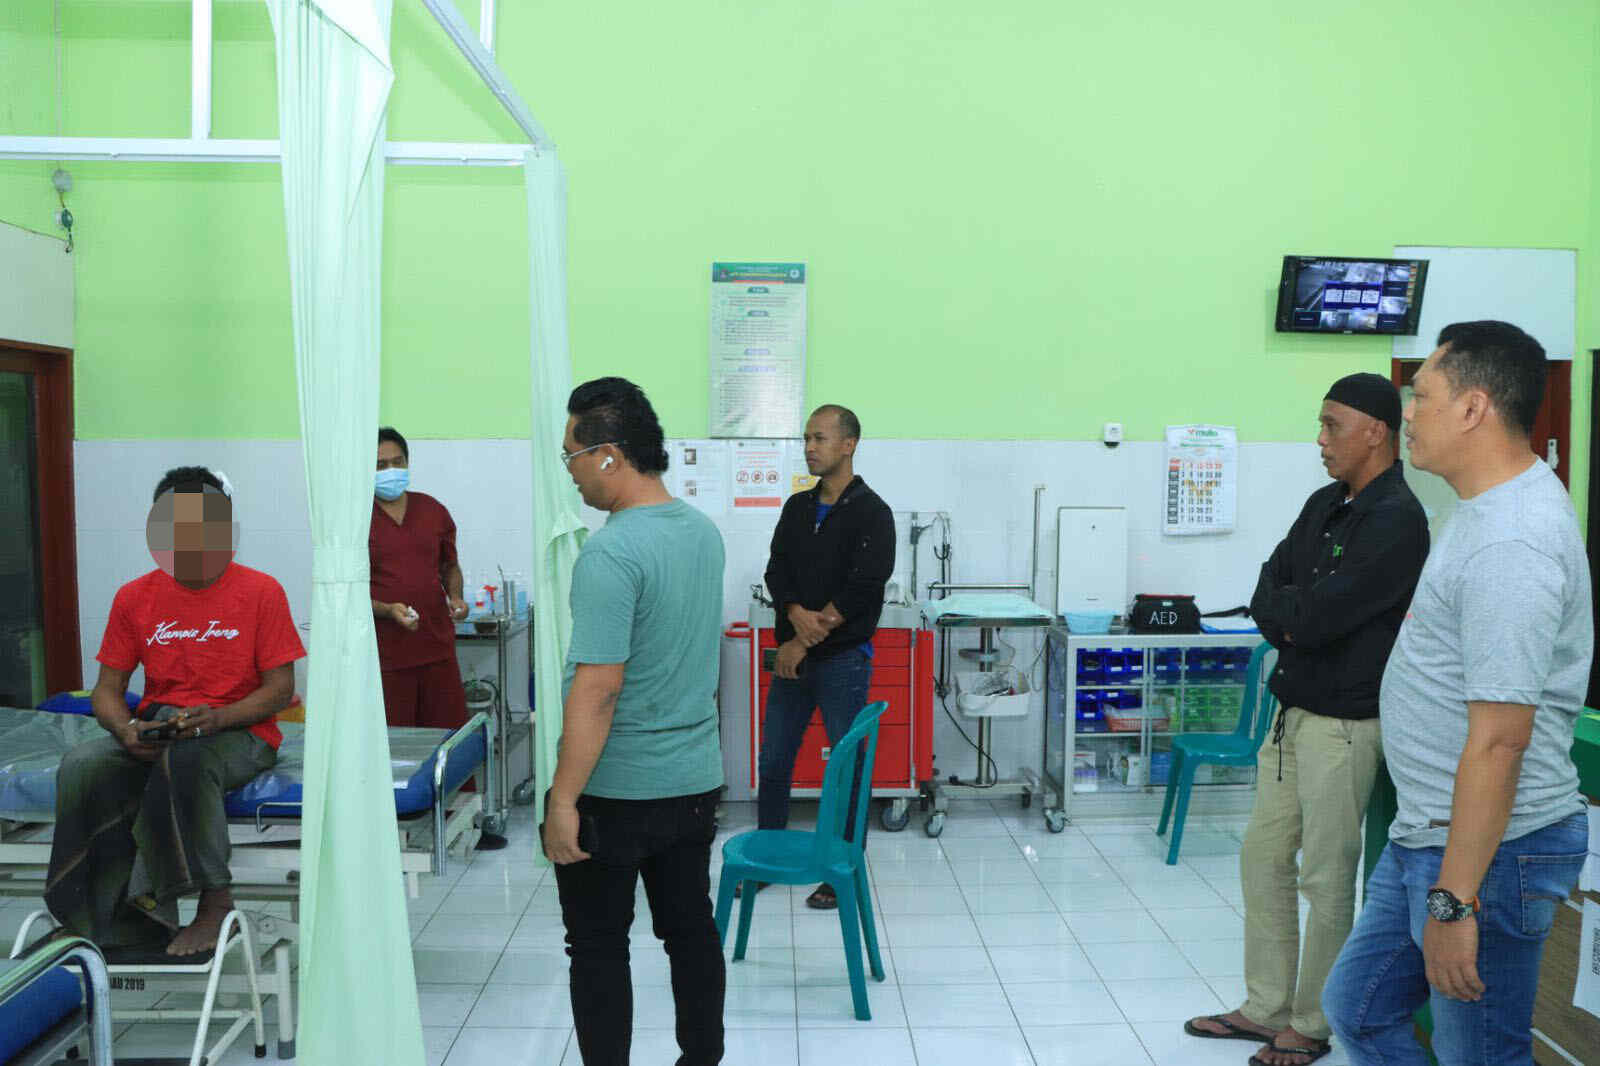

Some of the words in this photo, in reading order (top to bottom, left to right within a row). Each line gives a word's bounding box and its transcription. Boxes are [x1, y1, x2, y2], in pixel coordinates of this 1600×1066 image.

[1148, 610, 1177, 625] AED
[195, 620, 240, 642] Ireng
[124, 977, 145, 991] 2019
